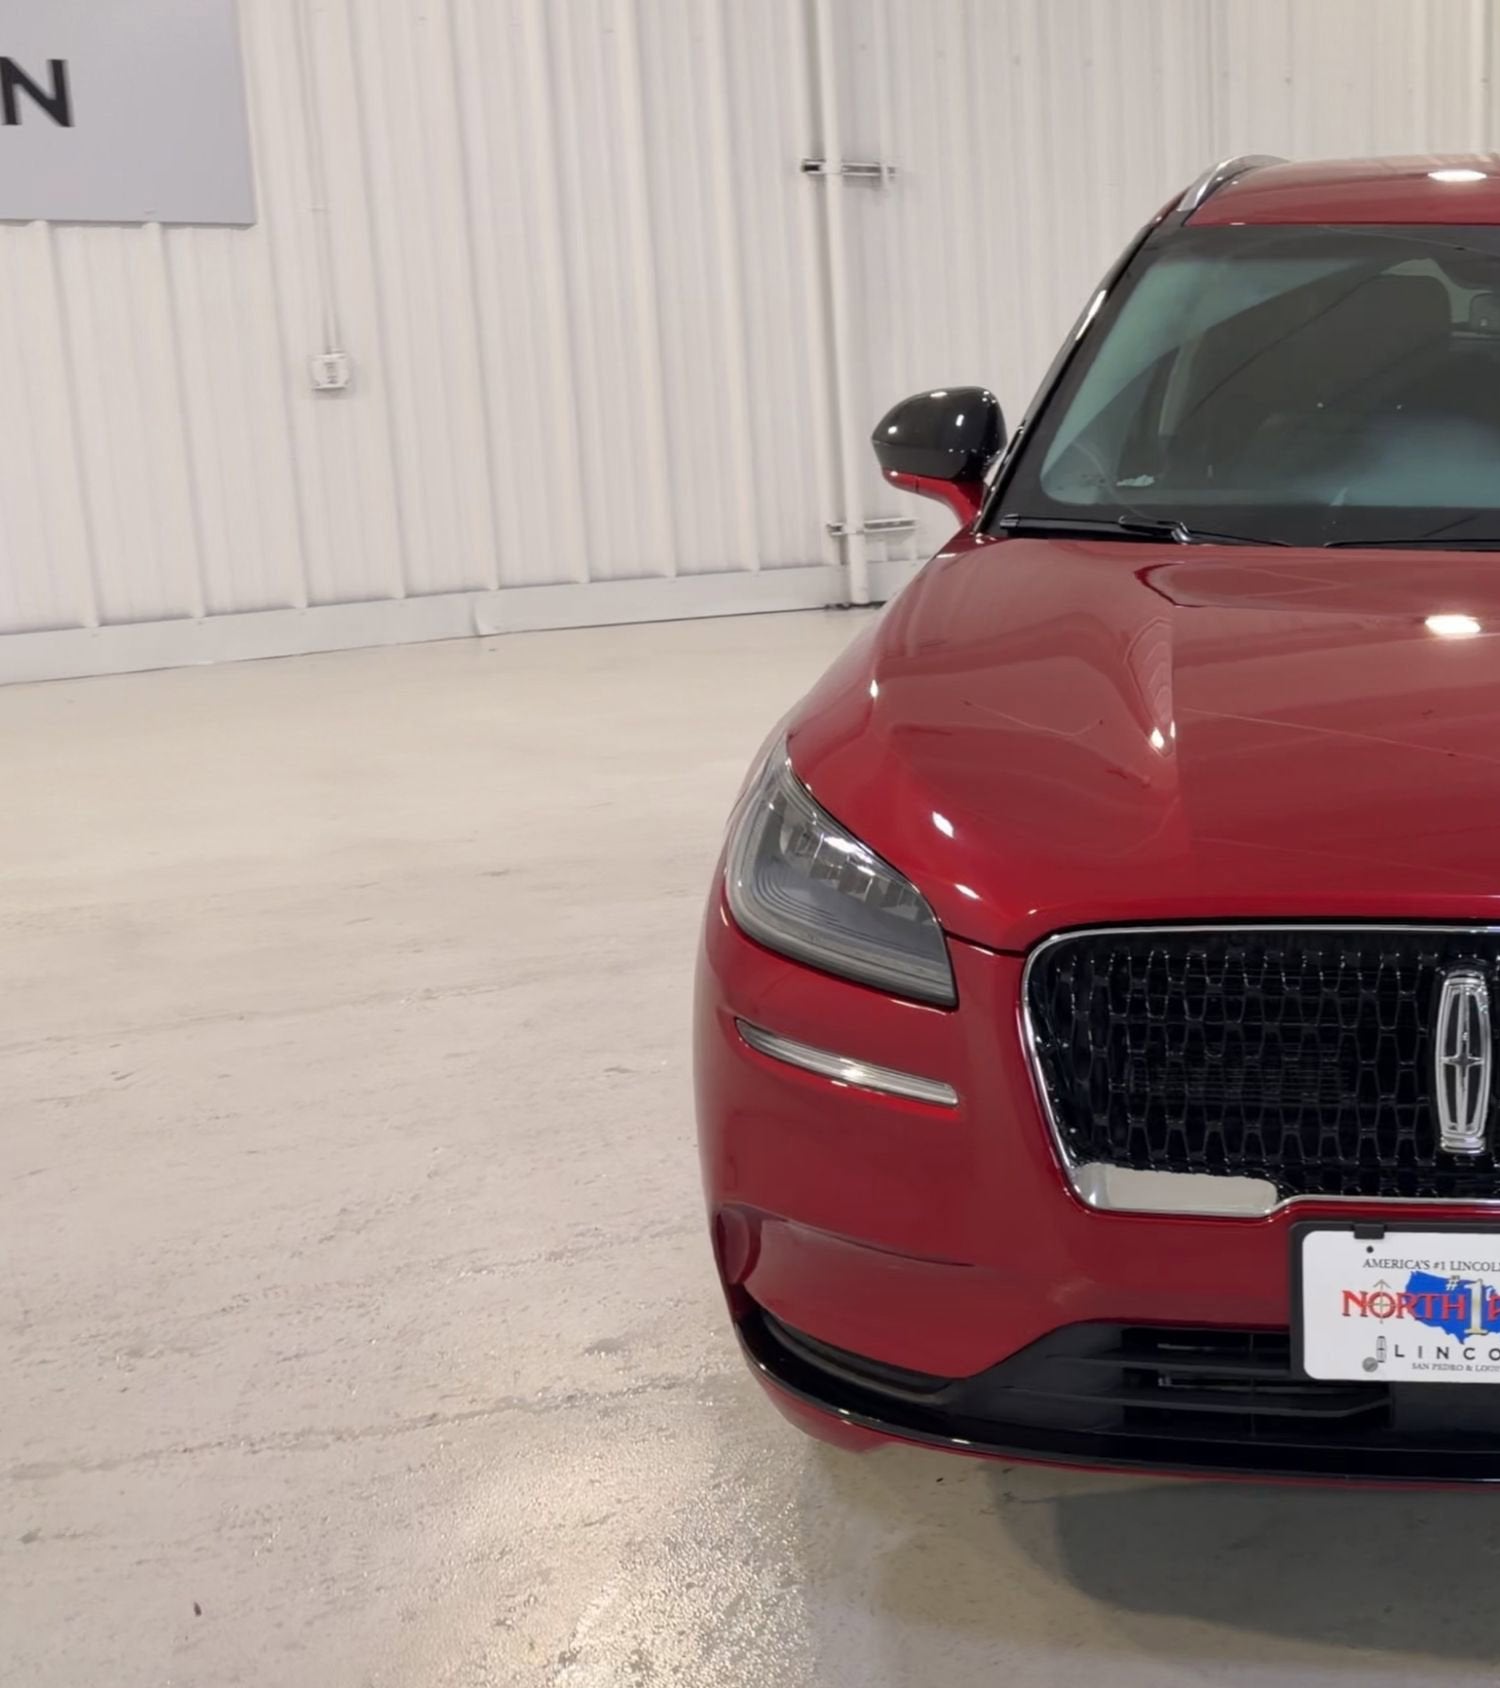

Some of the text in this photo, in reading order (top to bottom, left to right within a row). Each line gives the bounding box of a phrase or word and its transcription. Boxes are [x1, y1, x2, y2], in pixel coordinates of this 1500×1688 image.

[0, 56, 74, 128] N
[1362, 1258, 1431, 1270] AMERICA'S
[1433, 1260, 1446, 1271] #1
[1341, 1289, 1466, 1321] NORTH
